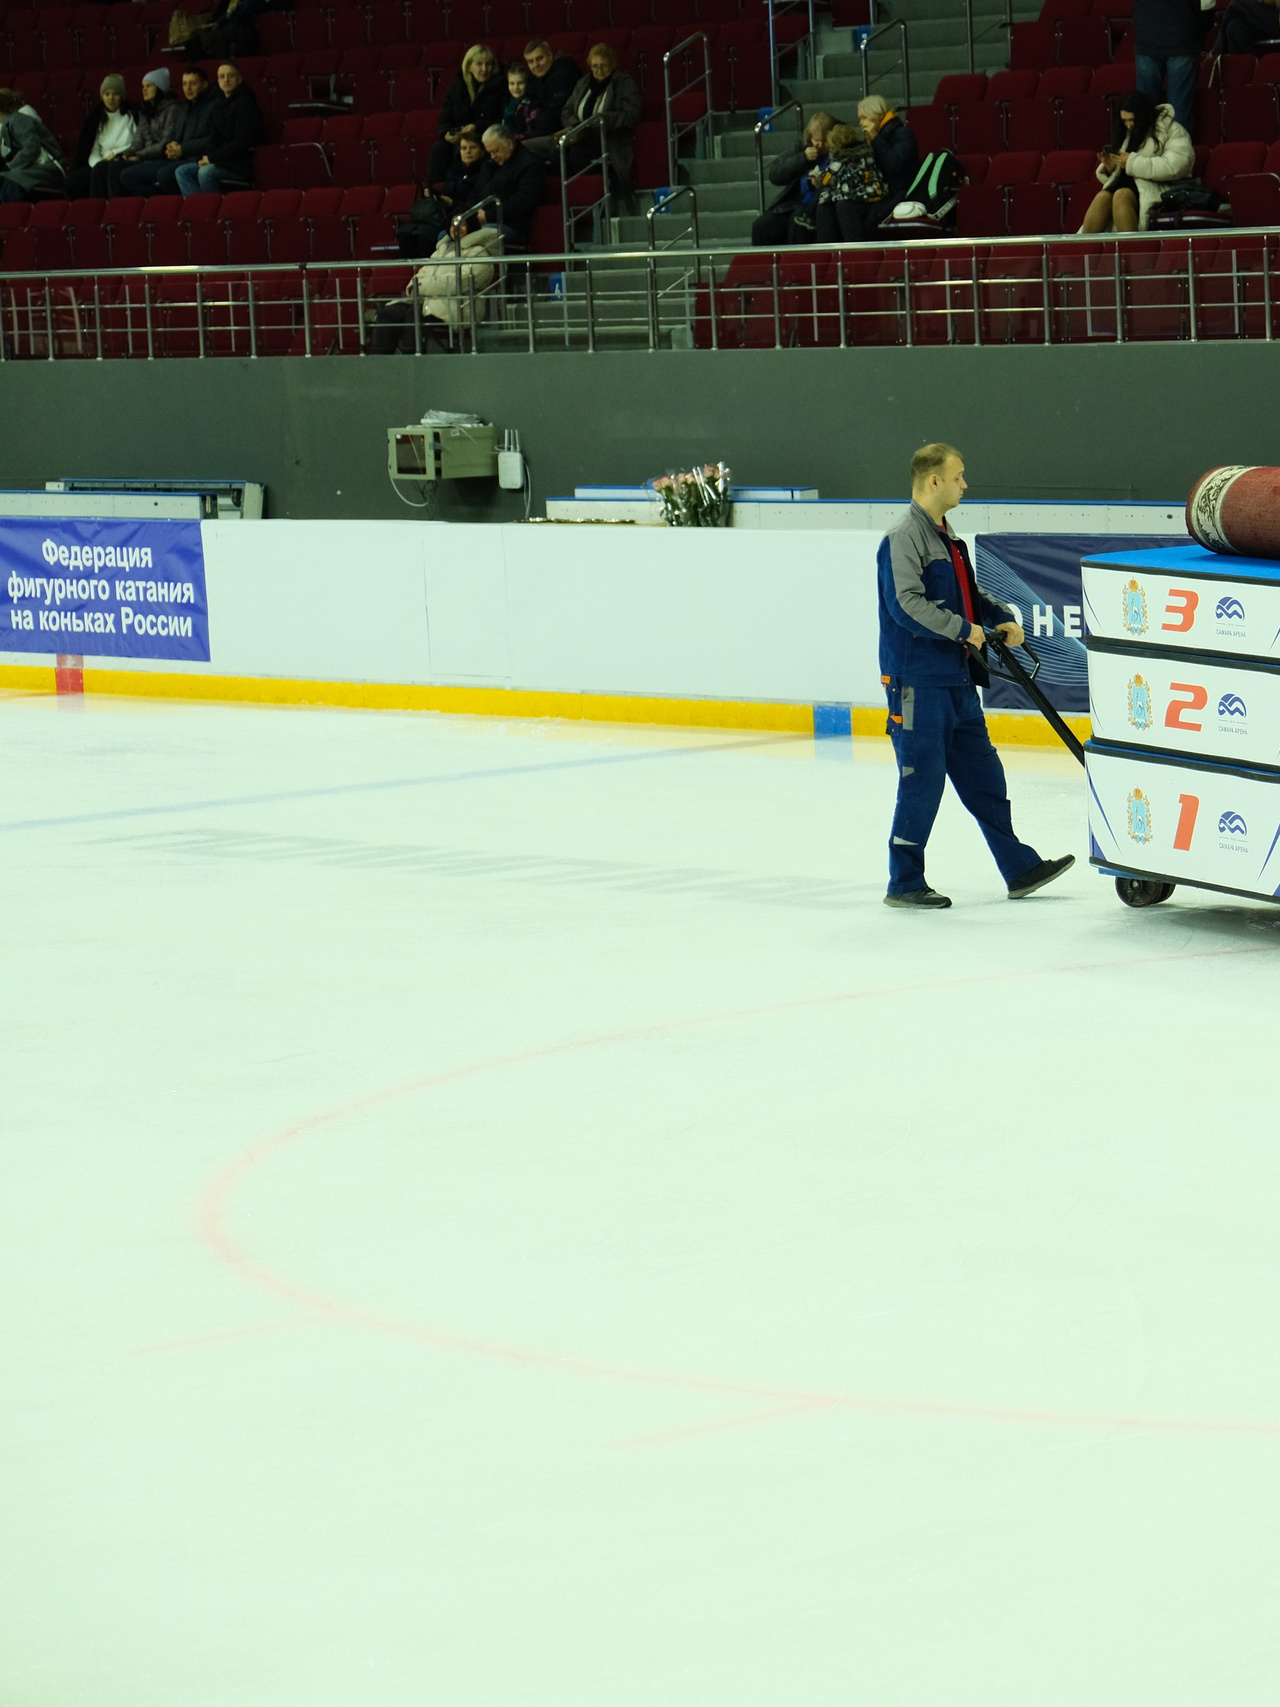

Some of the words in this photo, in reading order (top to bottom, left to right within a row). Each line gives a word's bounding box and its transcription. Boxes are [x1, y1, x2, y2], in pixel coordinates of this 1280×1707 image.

[42, 538, 152, 573] Федерация
[8, 571, 109, 605] фигурного
[115, 580, 194, 603] катания
[11, 609, 34, 630] на
[39, 610, 116, 633] коньках
[120, 606, 192, 637] России
[1007, 604, 1082, 637] НЕ
[1161, 588, 1199, 632] 3
[1164, 682, 1208, 732] 2
[1173, 793, 1200, 851] 1
